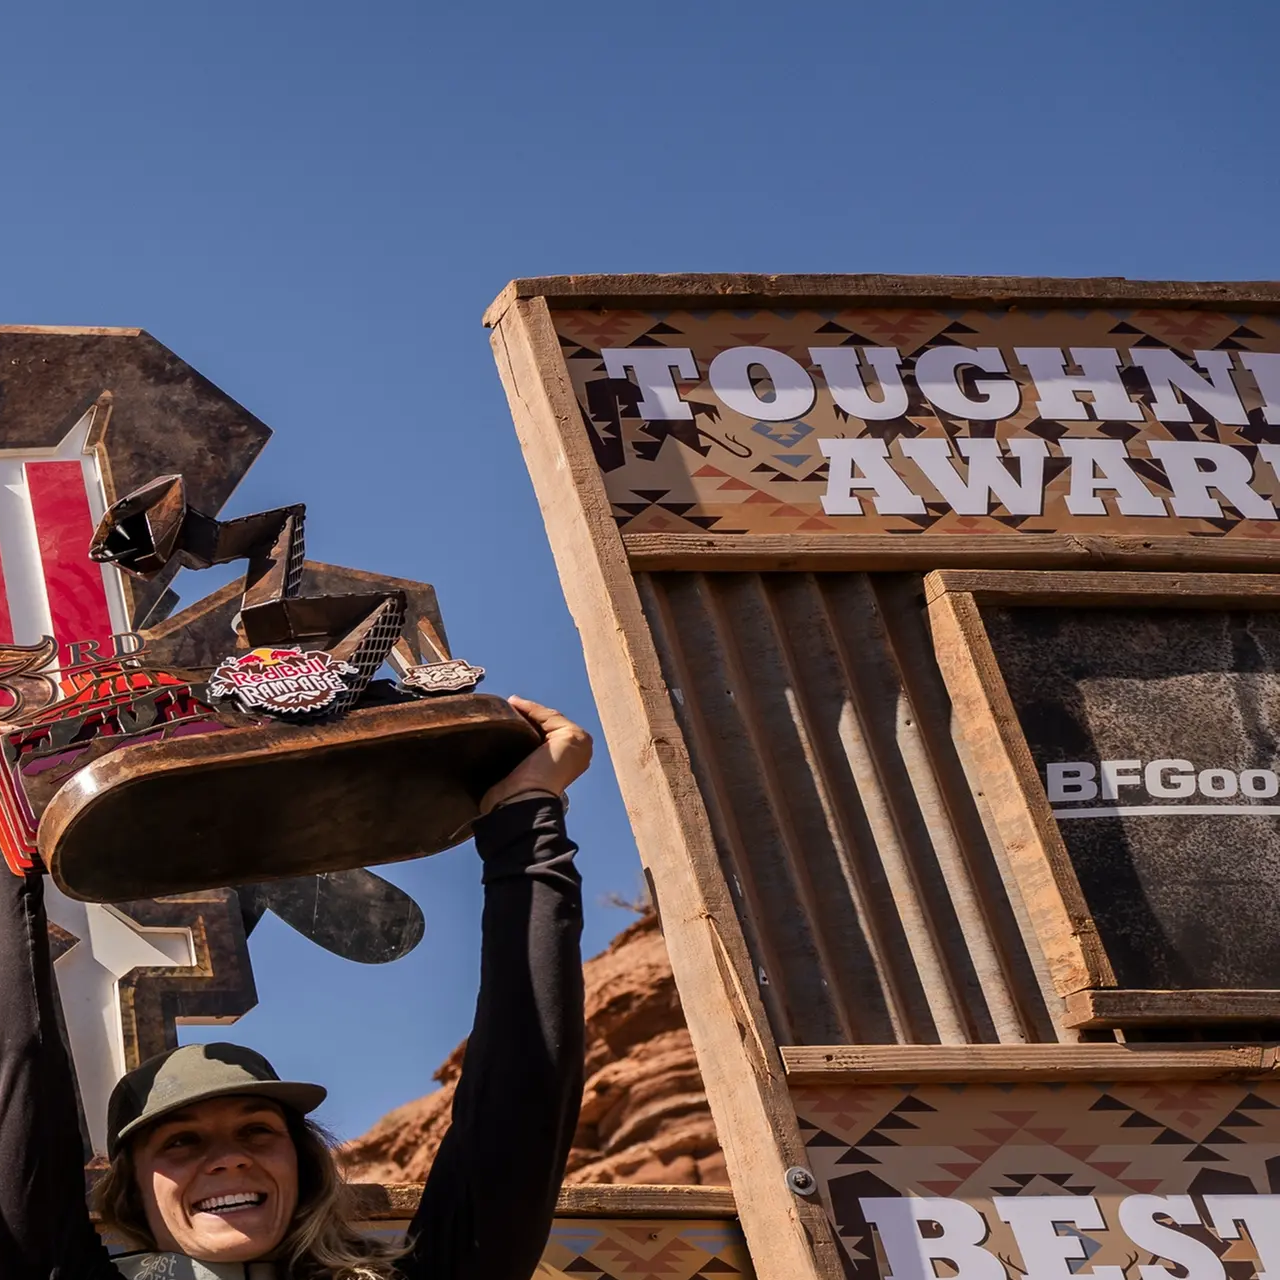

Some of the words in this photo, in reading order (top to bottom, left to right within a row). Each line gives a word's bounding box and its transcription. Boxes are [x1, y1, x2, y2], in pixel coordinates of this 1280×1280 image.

[818, 438, 1280, 520] AWAR
[232, 666, 279, 686] Red
[280, 658, 327, 678] Bull
[240, 671, 348, 707] RAMPAGE
